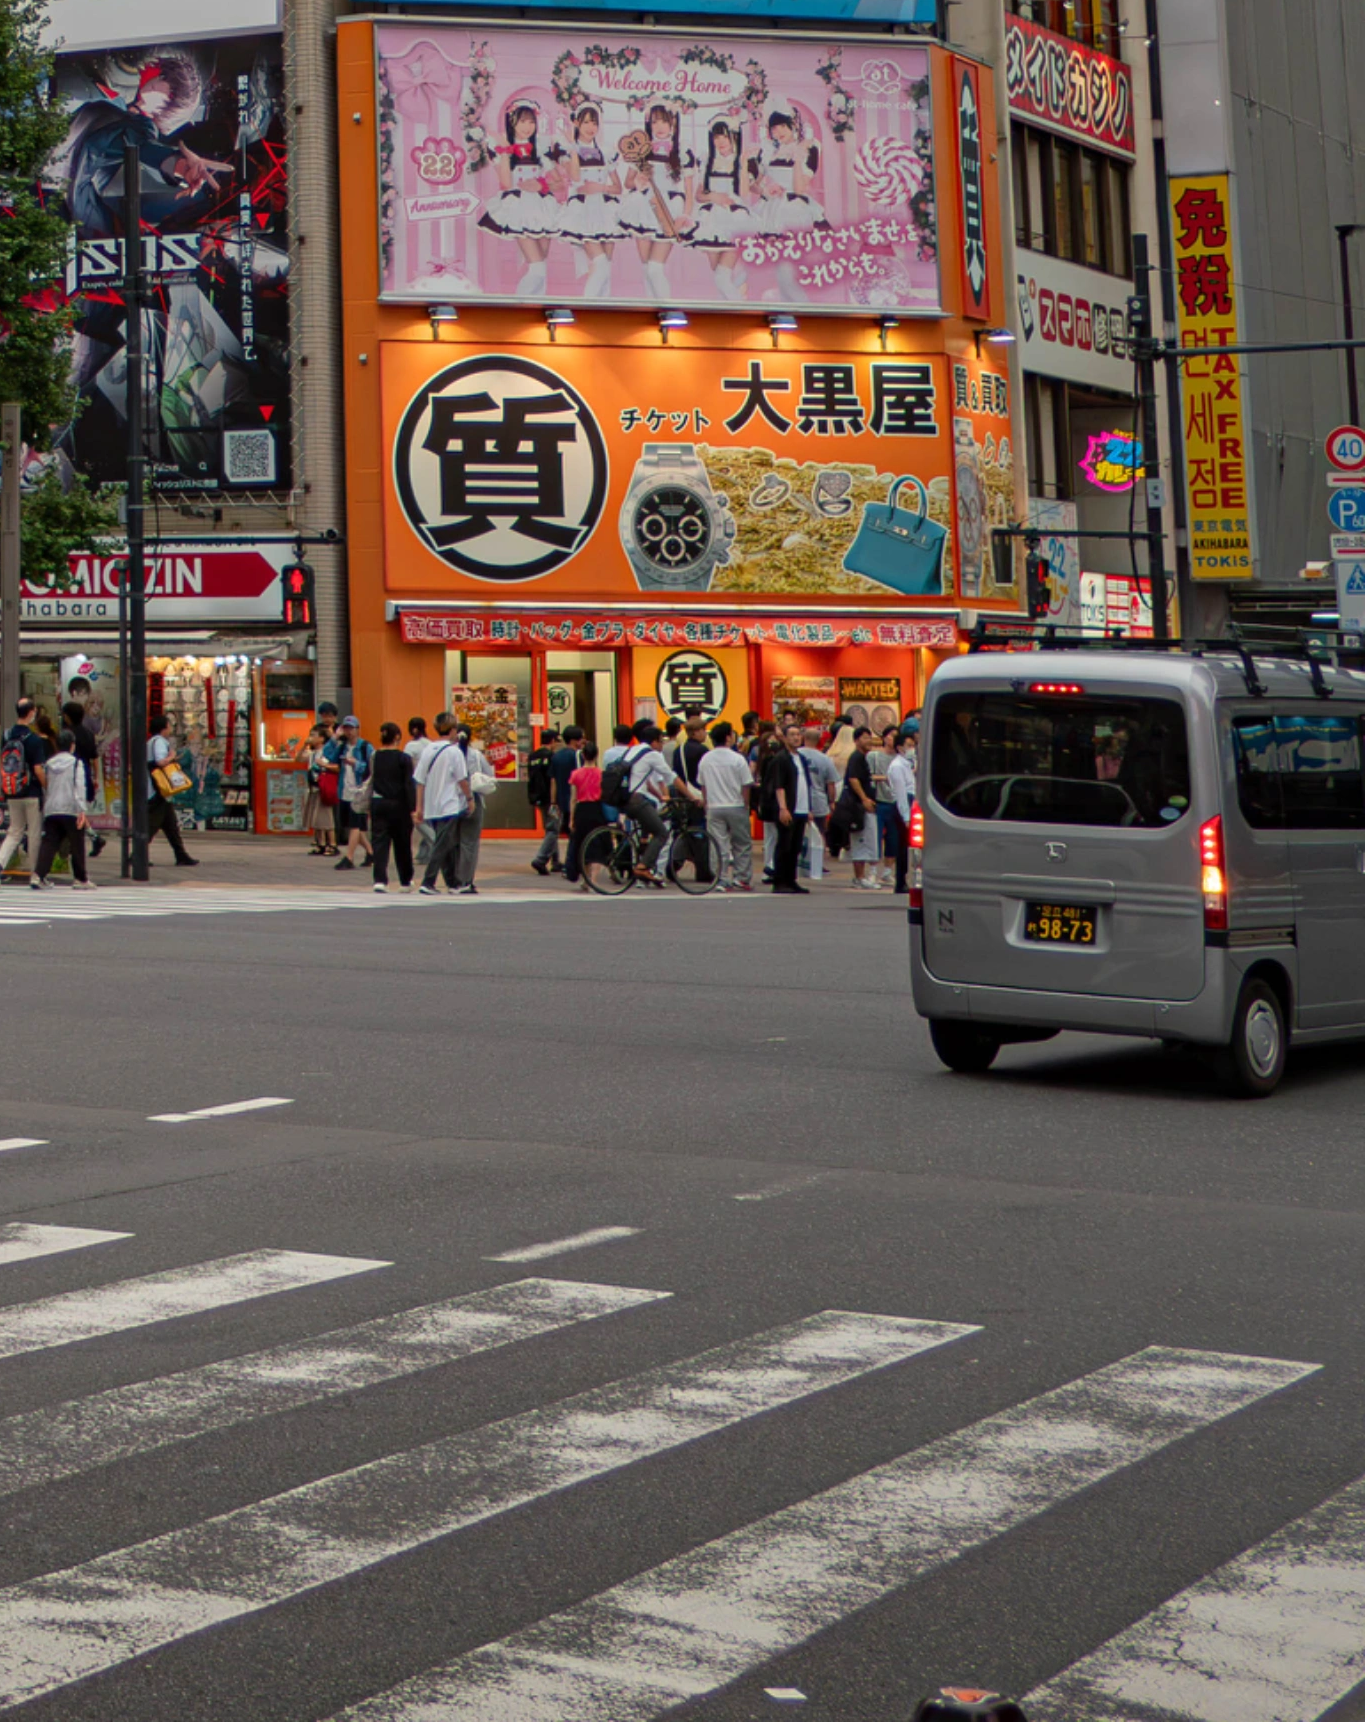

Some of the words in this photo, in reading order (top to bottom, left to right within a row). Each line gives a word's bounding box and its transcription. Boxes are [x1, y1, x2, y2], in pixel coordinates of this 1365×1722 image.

[589, 65, 671, 95] Welcome
[674, 68, 732, 95] Home
[1004, 23, 1133, 143] メイドカジノ
[420, 153, 456, 177] 22
[797, 252, 888, 287] これからも。
[1174, 187, 1232, 317] 免税
[1038, 287, 1137, 363] スマホ修理
[1210, 327, 1237, 401] TAX
[722, 359, 940, 438] 大黒屋
[619, 406, 711, 436] チケット
[1217, 412, 1246, 510] FREE
[1336, 438, 1362, 459] 40
[421, 390, 589, 553] 質
[1338, 500, 1357, 527] P
[1192, 537, 1249, 551] AKIHABARA
[404, 616, 484, 641] 高価買取
[665, 660, 718, 723] 質
[842, 679, 899, 699] WANTED
[1039, 917, 1093, 955] 98-73
